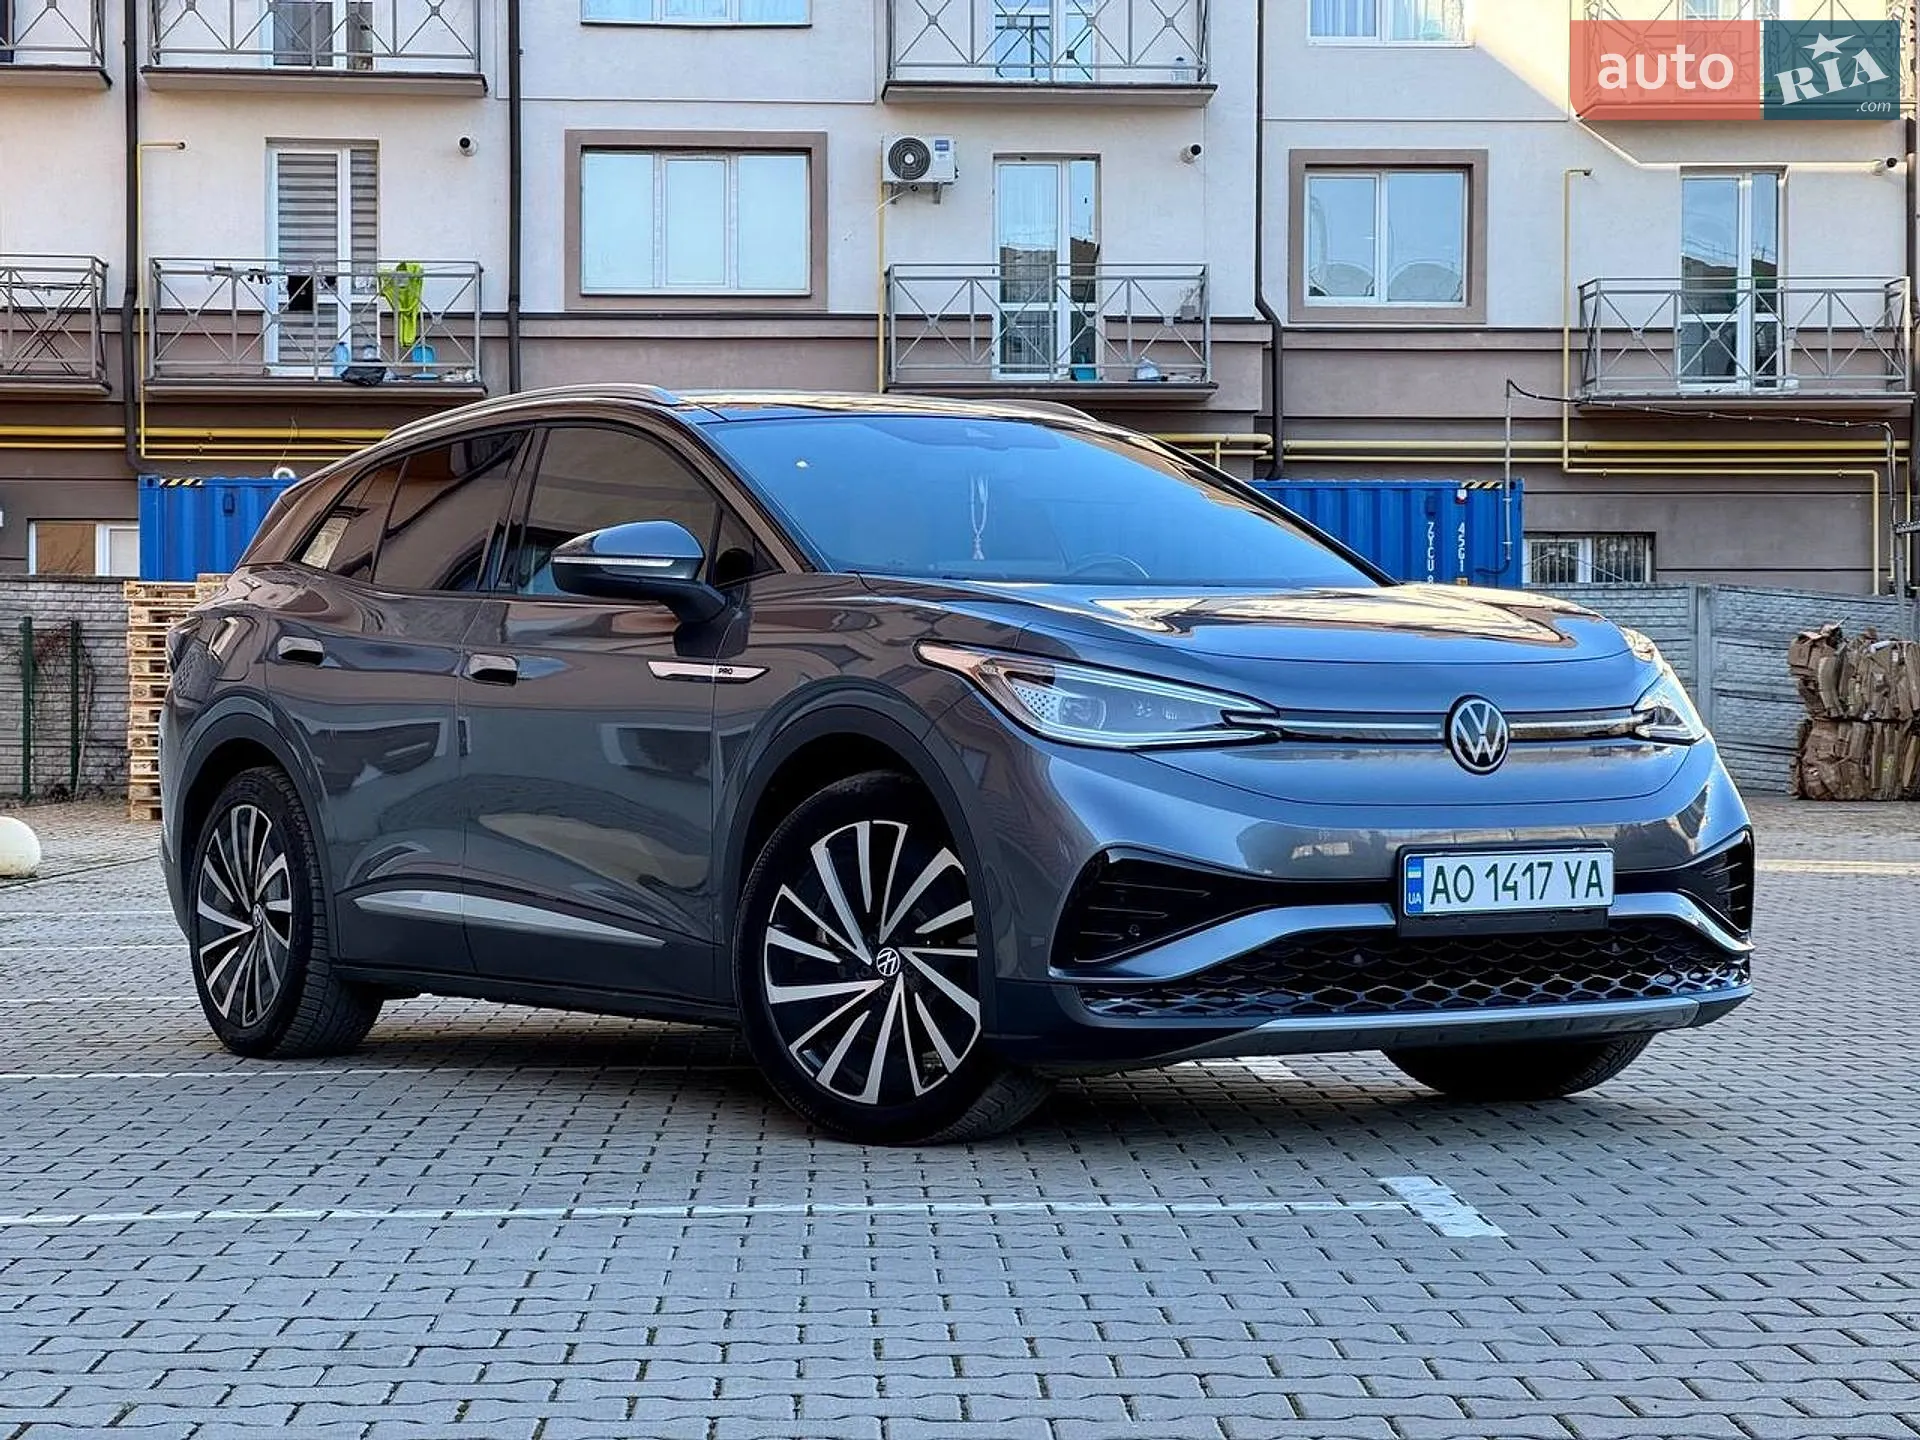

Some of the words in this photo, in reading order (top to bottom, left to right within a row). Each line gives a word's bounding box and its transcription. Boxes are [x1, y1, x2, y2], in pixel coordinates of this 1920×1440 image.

[1427, 521, 1435, 571] ZYCU
[1457, 522, 1466, 572] 45G1
[718, 667, 733, 675] PRO
[1408, 892, 1421, 904] UA
[1430, 864, 1474, 904] AO
[1484, 861, 1553, 901] 1417
[1564, 859, 1604, 899] YA
